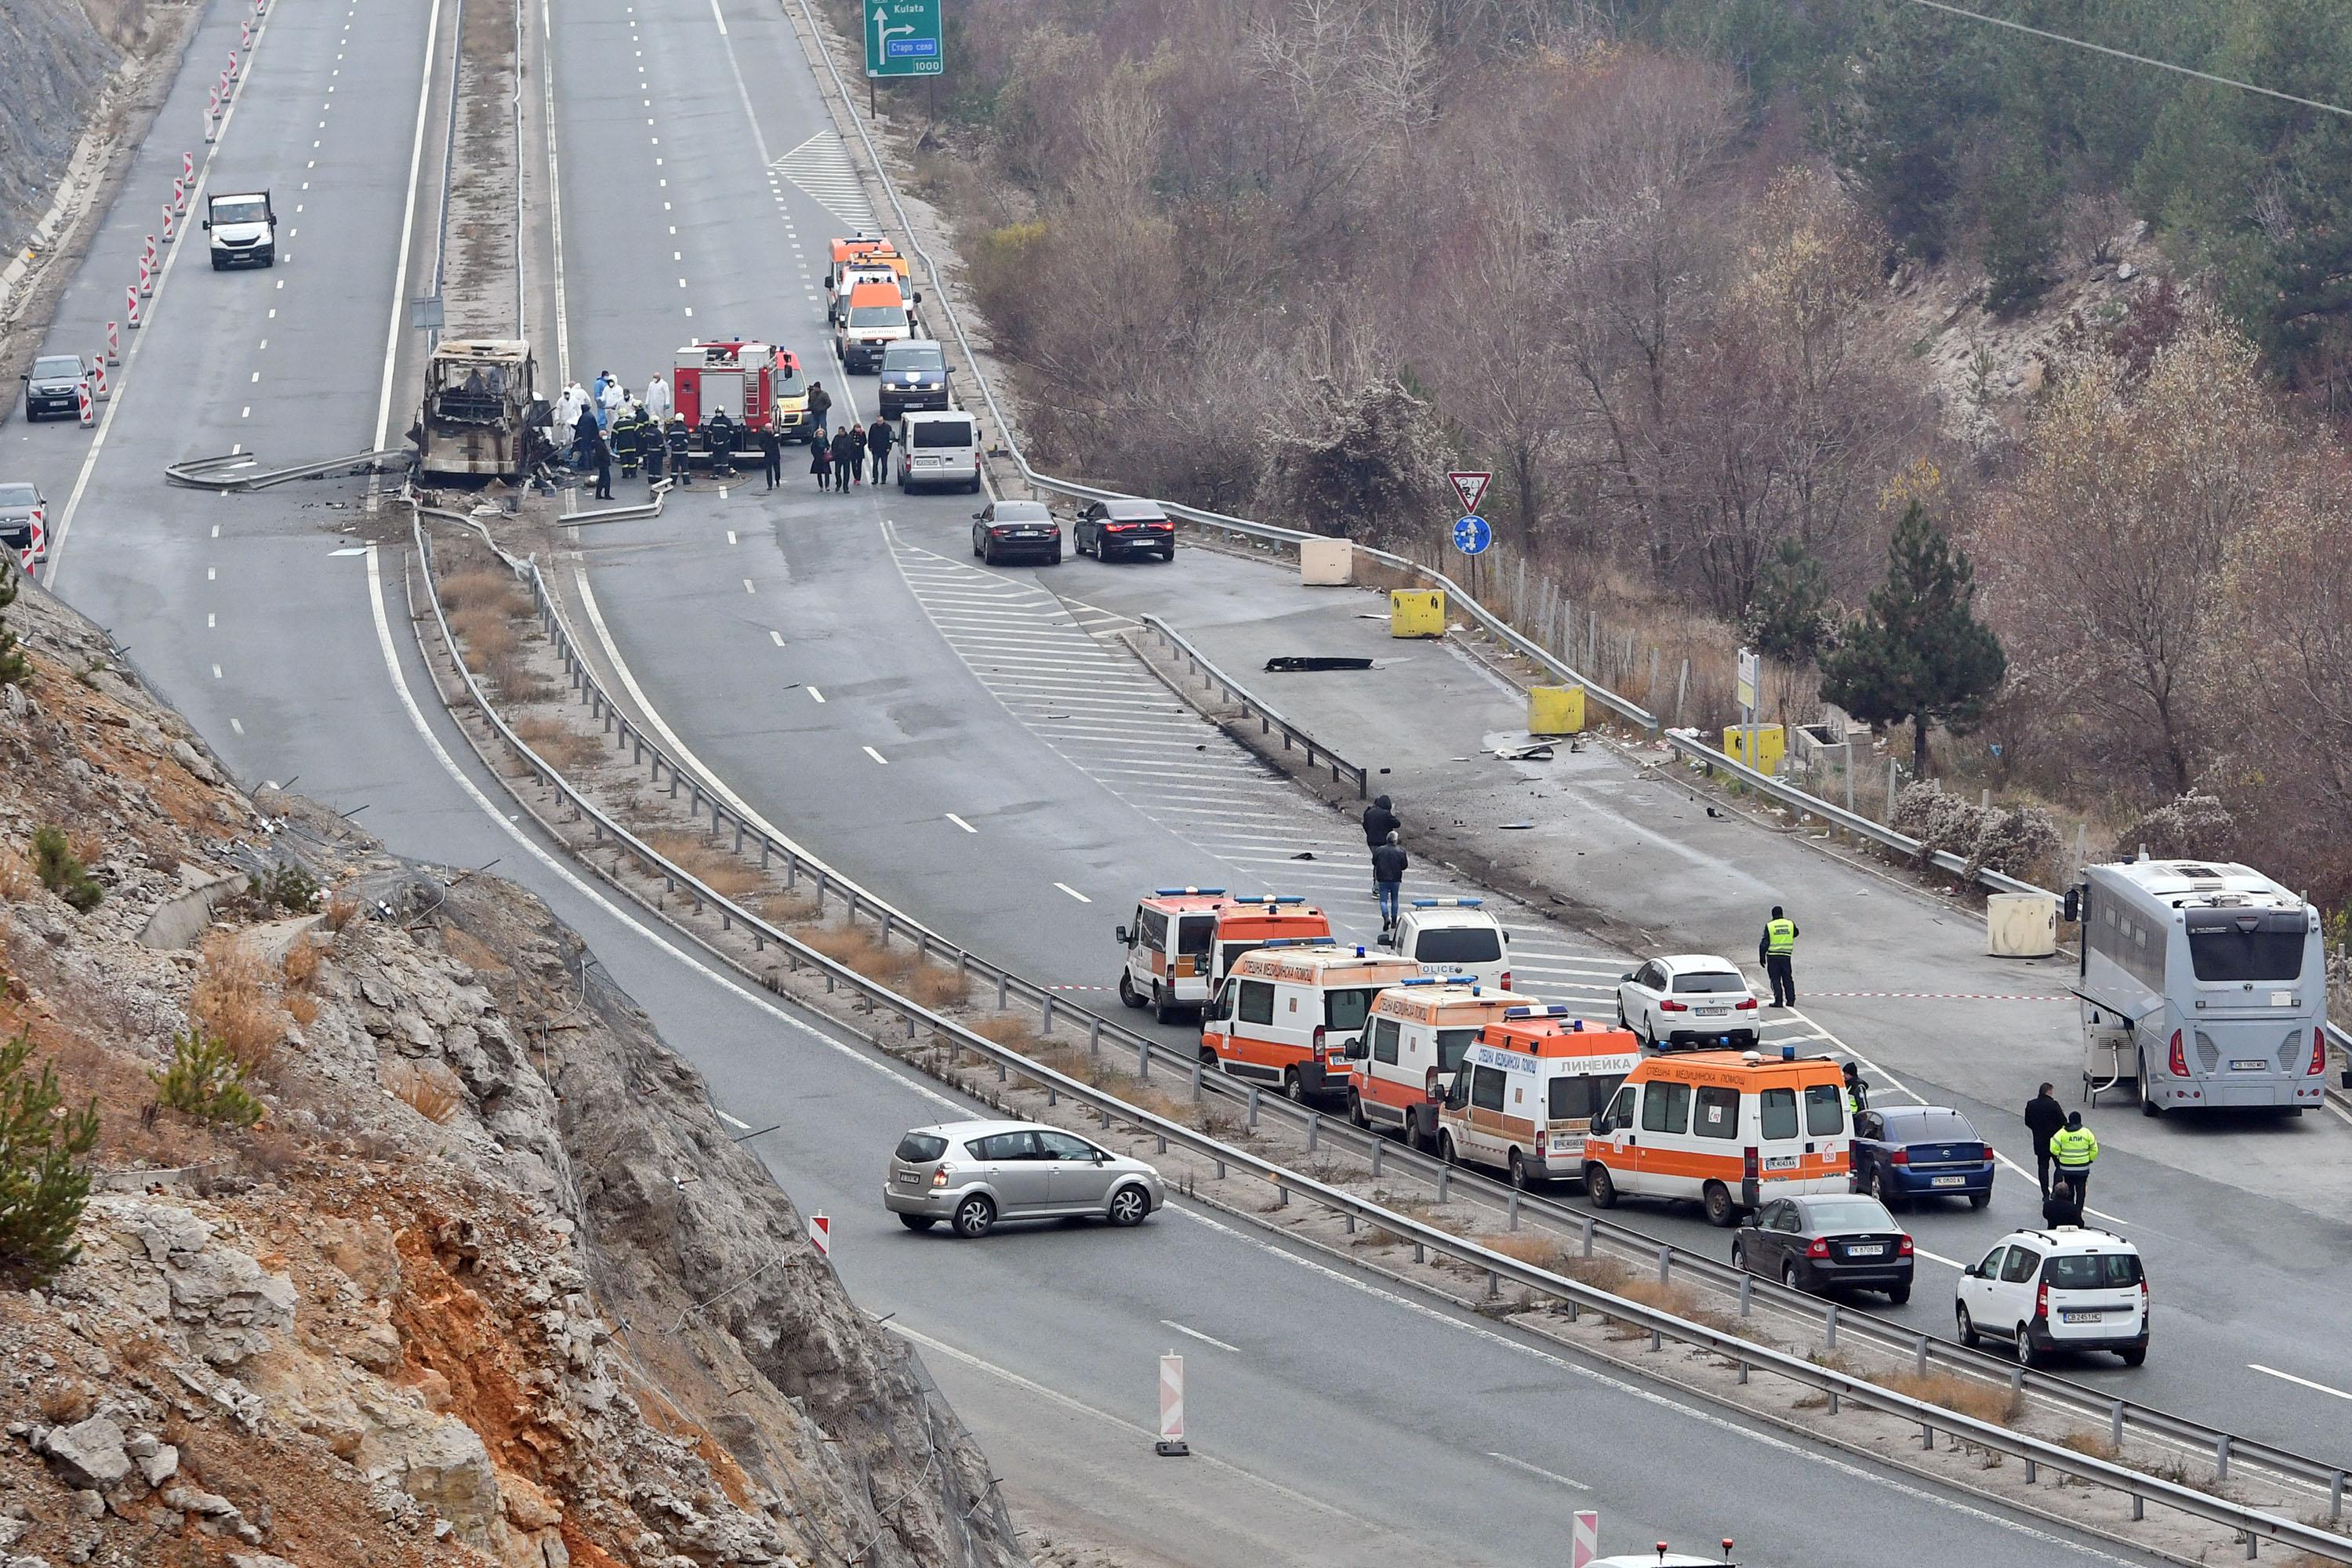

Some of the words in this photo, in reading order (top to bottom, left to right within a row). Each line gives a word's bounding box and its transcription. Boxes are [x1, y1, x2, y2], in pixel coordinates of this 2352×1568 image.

[894, 5, 924, 13] Kulata
[891, 43, 913, 53] Старо
[916, 62, 939, 71] 1000
[1264, 962, 1294, 981] МЕДИЦИНСКА
[1561, 1057, 1632, 1073] ЛИНЕЙКА
[1646, 1066, 1671, 1076] СПЕШНА
[1675, 1069, 1715, 1081] МЕДИЦИНСКА
[1720, 1074, 1745, 1085] ПОМОЩ
